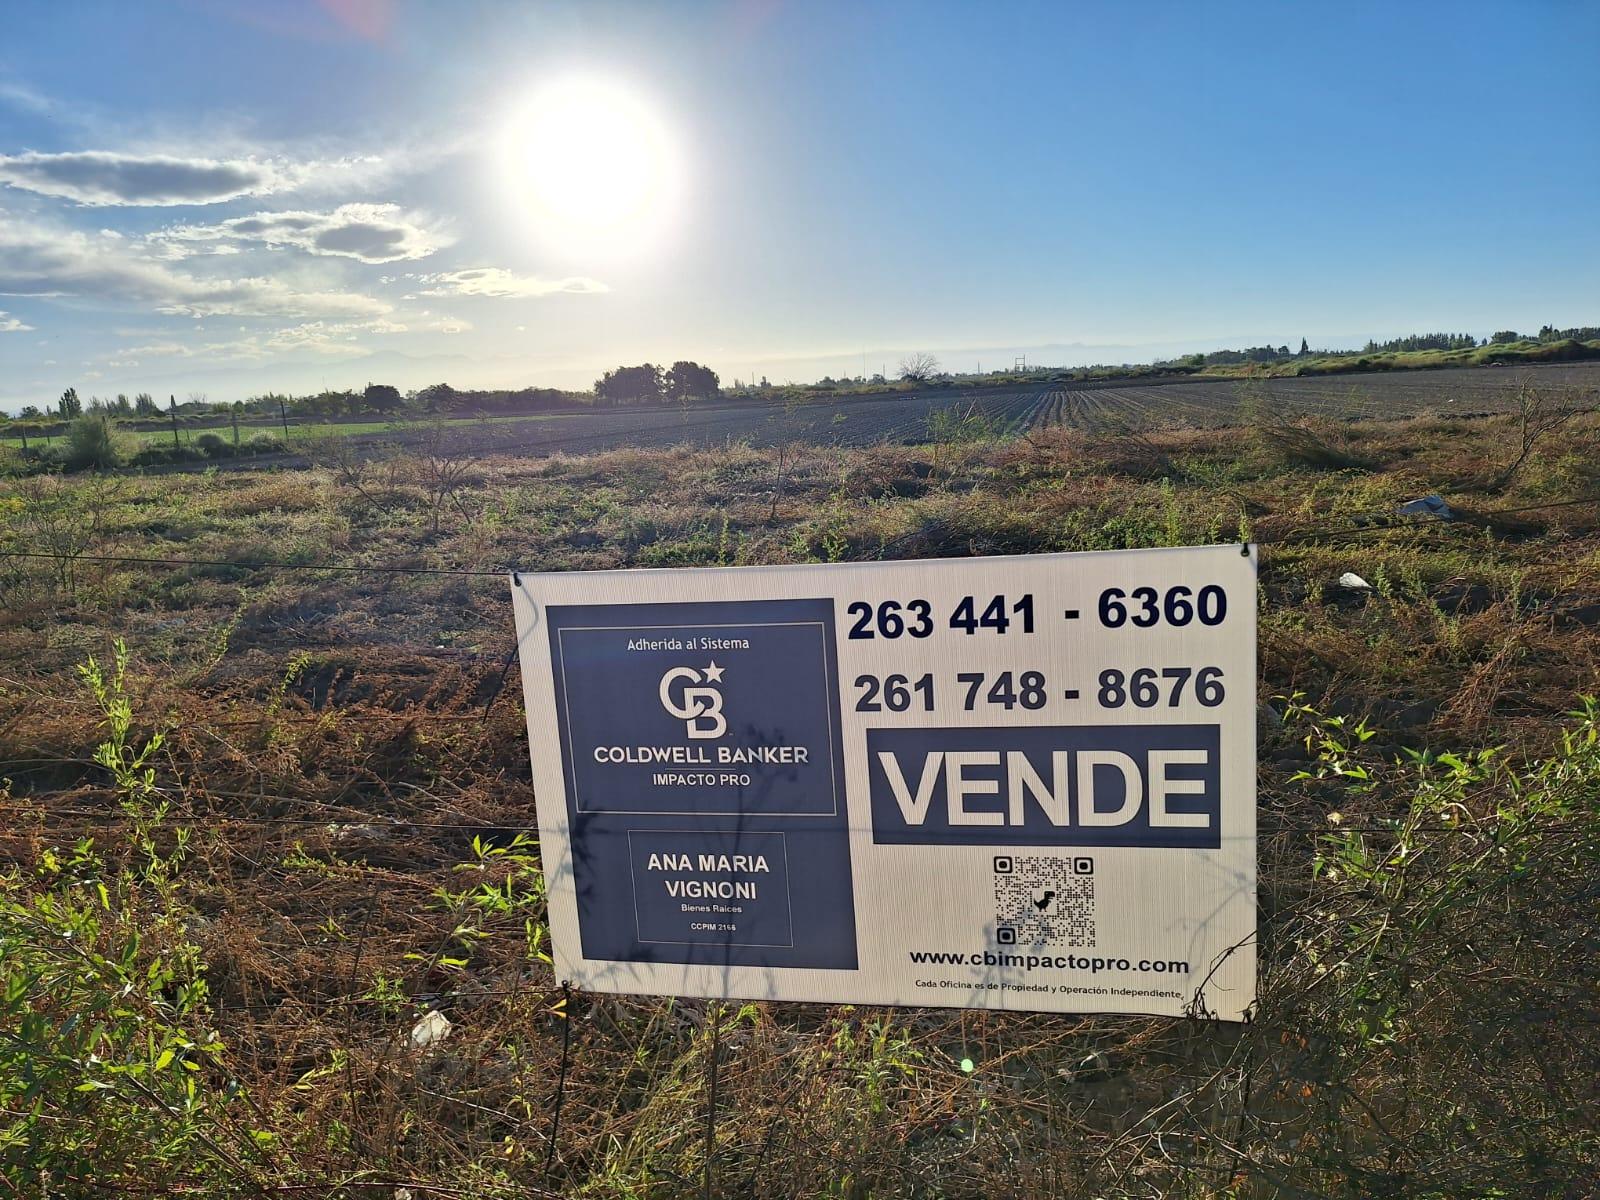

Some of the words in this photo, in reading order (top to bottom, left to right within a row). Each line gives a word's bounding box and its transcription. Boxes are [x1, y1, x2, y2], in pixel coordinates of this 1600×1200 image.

[847, 599, 933, 639] 263
[949, 594, 1034, 635] 441
[1064, 609, 1080, 619] -
[1098, 584, 1228, 628] 6360
[627, 638, 682, 651] Adherida
[686, 638, 697, 650] al
[701, 637, 750, 649] Sistema
[854, 673, 934, 712] 261
[957, 670, 1047, 711] 748
[1064, 690, 1080, 699] -
[1098, 666, 1227, 709] 8676
[593, 746, 711, 764] COLDWELL
[717, 746, 809, 763] BANKER
[652, 773, 716, 786] IMPACTO
[720, 774, 751, 786] PRO
[877, 749, 1210, 828] VENDE
[647, 853, 693, 871] ANA
[698, 854, 770, 873] MARIA
[665, 880, 756, 899] VIGNONI
[681, 903, 711, 912] Bienes
[690, 922, 717, 930] CCPIM
[909, 950, 1190, 974] www.cbimpactopro.com
[915, 979, 937, 988] Cada
[940, 980, 972, 989] Oficina
[987, 982, 999, 990] de
[1001, 983, 1049, 993] Propiedad
[1051, 986, 1057, 994] y
[1059, 985, 1108, 995] Operación
